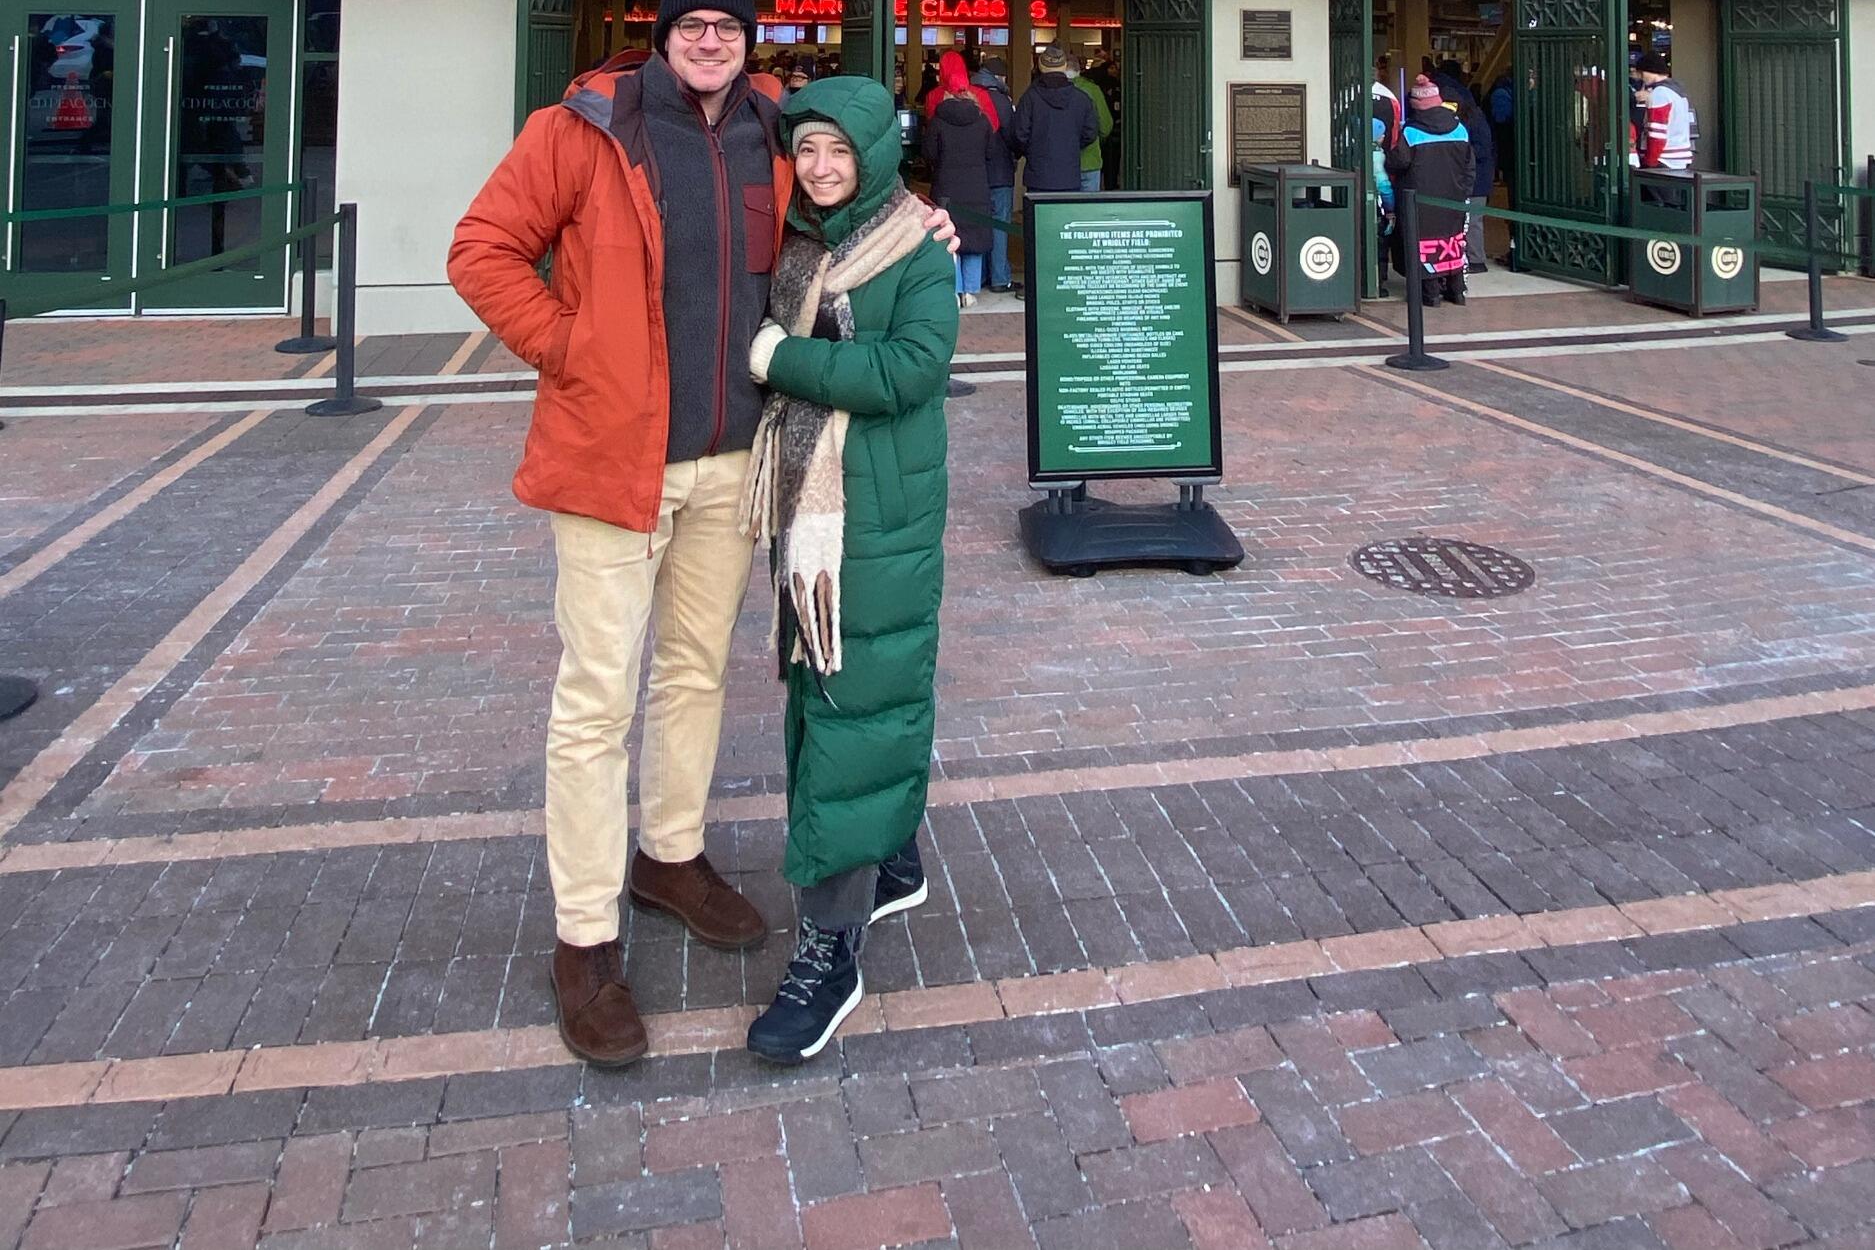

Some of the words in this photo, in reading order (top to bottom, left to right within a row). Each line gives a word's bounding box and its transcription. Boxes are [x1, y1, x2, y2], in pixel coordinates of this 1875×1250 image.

[1074, 231, 1110, 239] FOLLOWING
[1111, 230, 1131, 239] ITEMS
[1132, 230, 1145, 238] ARE
[1145, 230, 1183, 238] PROHIBITED
